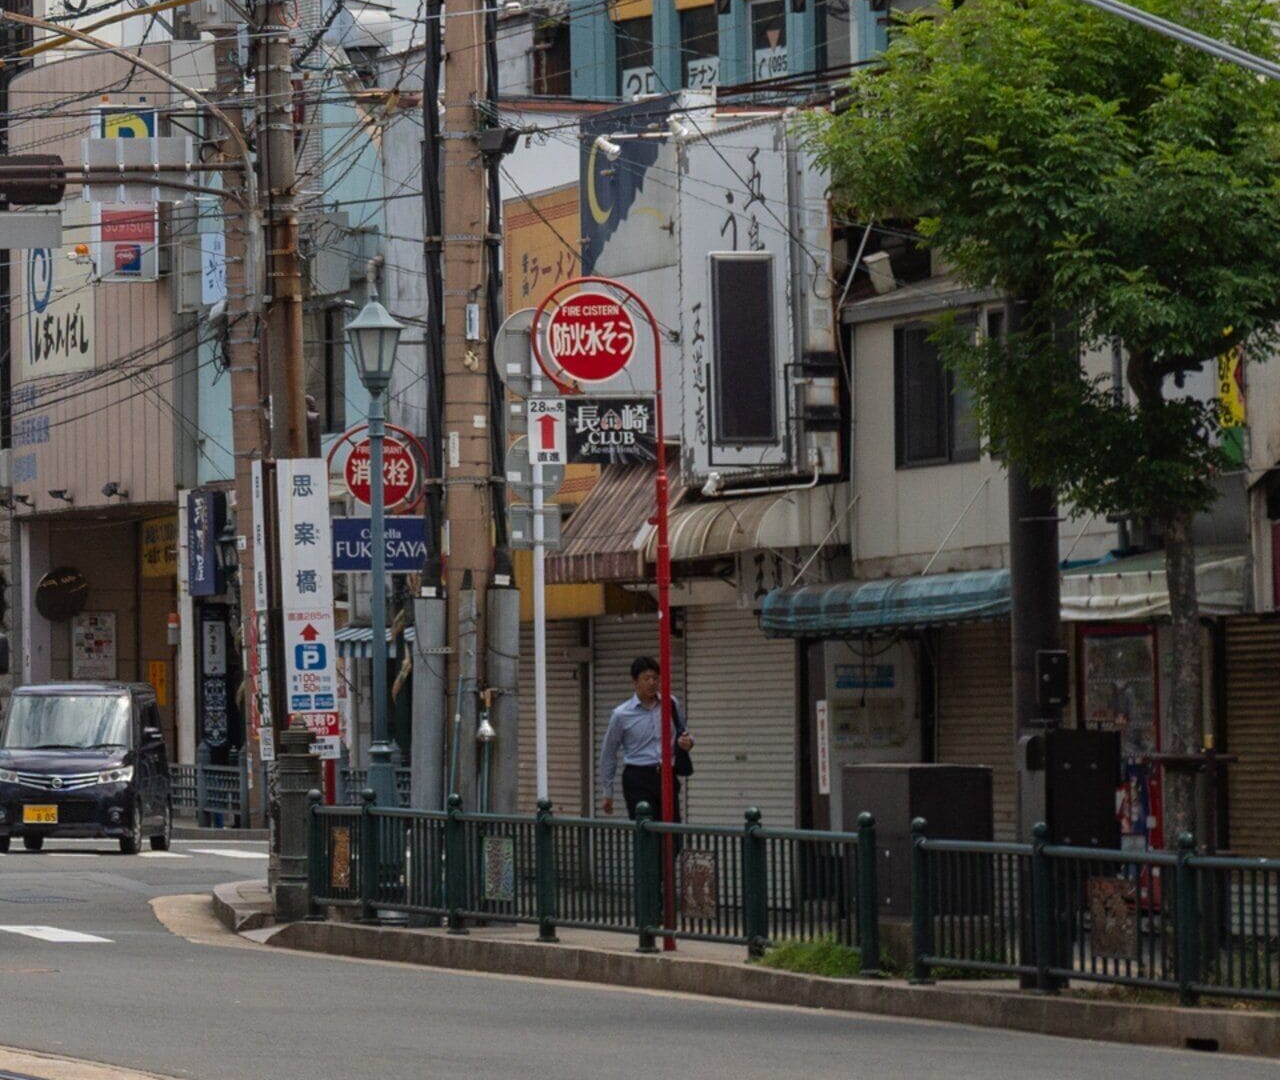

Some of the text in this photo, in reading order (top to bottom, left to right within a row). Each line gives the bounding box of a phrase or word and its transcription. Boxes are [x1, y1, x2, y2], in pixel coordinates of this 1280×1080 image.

[562, 304, 620, 317] FIRE CISTERN
[552, 321, 633, 357] 防火水そう
[573, 404, 650, 434] 長崎
[588, 430, 636, 446] CLUB
[537, 451, 561, 462] 直進
[292, 474, 318, 595] 思案橋
[360, 528, 402, 540] Caella
[335, 540, 428, 558] FUKSAYA
[302, 651, 320, 669] P
